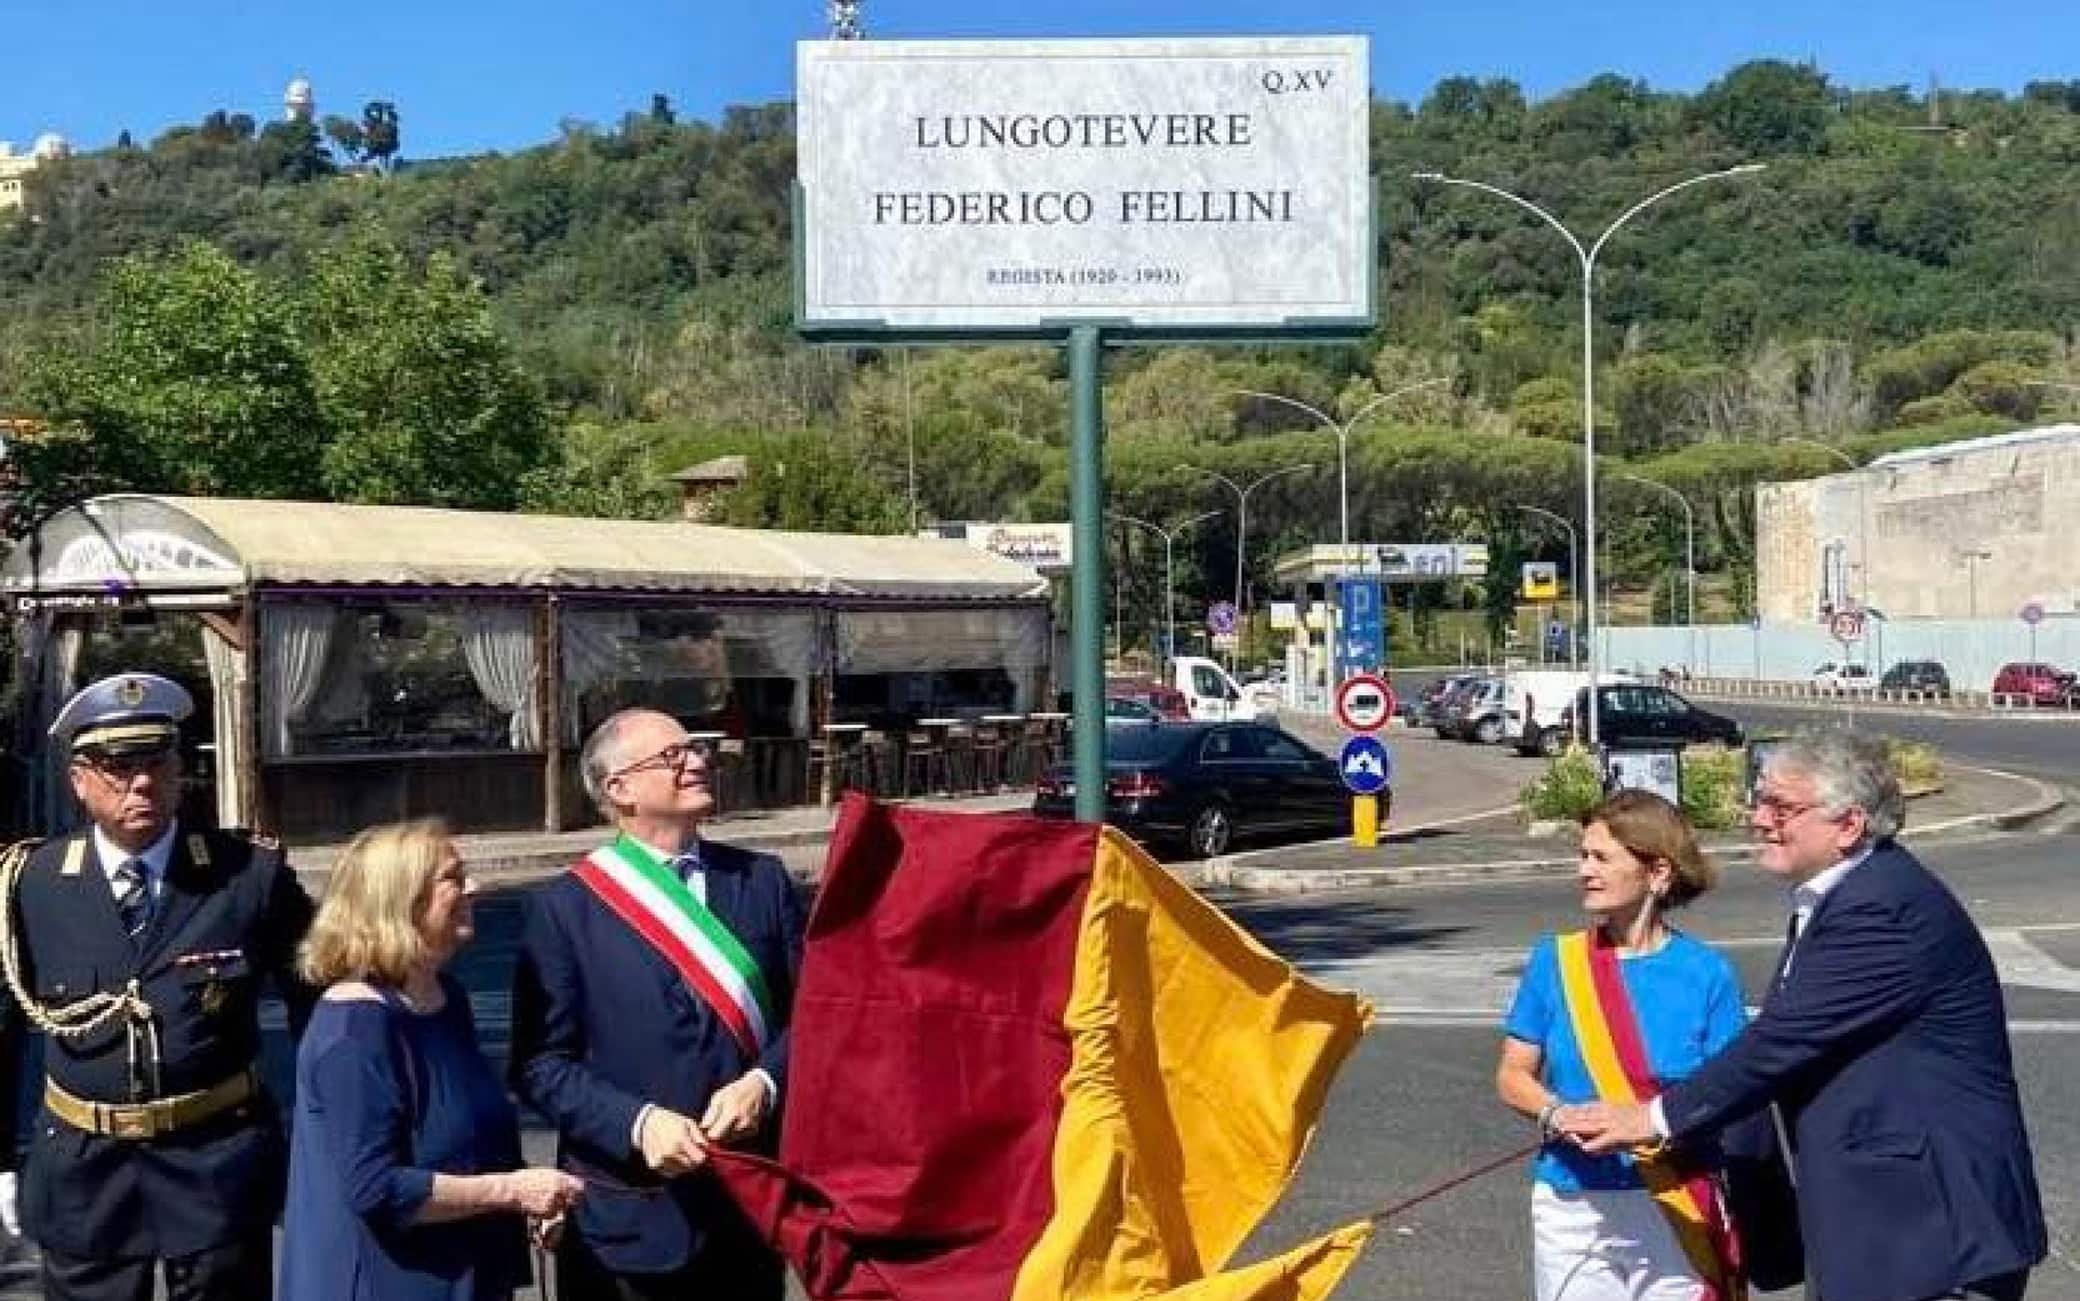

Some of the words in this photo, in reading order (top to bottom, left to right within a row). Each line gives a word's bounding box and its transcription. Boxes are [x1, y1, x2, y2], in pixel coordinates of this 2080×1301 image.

[1262, 70, 1335, 94] Q.XV
[915, 114, 1252, 148] LUNGOTEVERE
[873, 191, 1094, 225] FEDERICO
[1120, 190, 1296, 223] FELLINI
